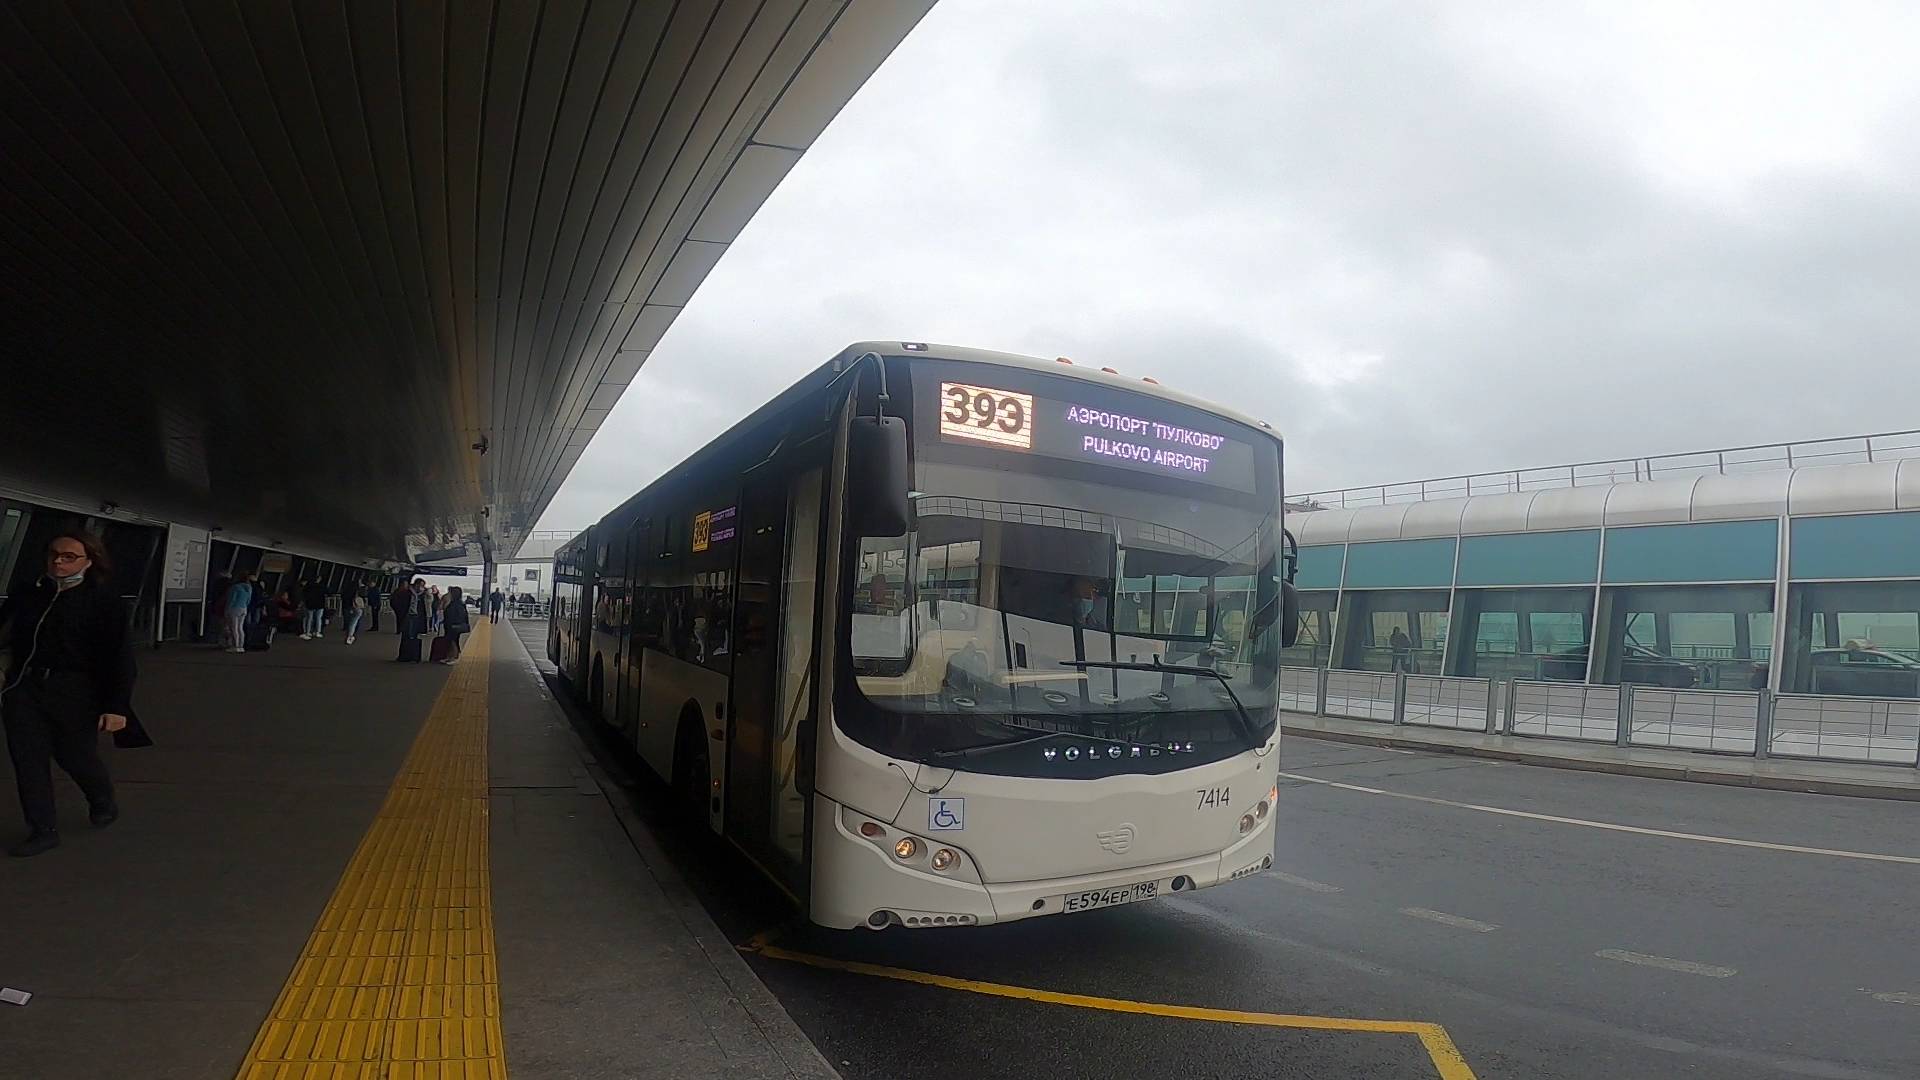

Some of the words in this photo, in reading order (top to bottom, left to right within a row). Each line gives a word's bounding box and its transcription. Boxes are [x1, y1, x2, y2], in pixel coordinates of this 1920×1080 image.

[1066, 405, 1149, 436] АЭРОПОРТ
[1152, 421, 1224, 451] "ПУЛКОВО"
[1083, 435, 1151, 462] PULKOVO
[1153, 449, 1209, 473] AIRPORT
[1043, 742, 1194, 761] VOLGABUS
[1197, 787, 1230, 810] 7414
